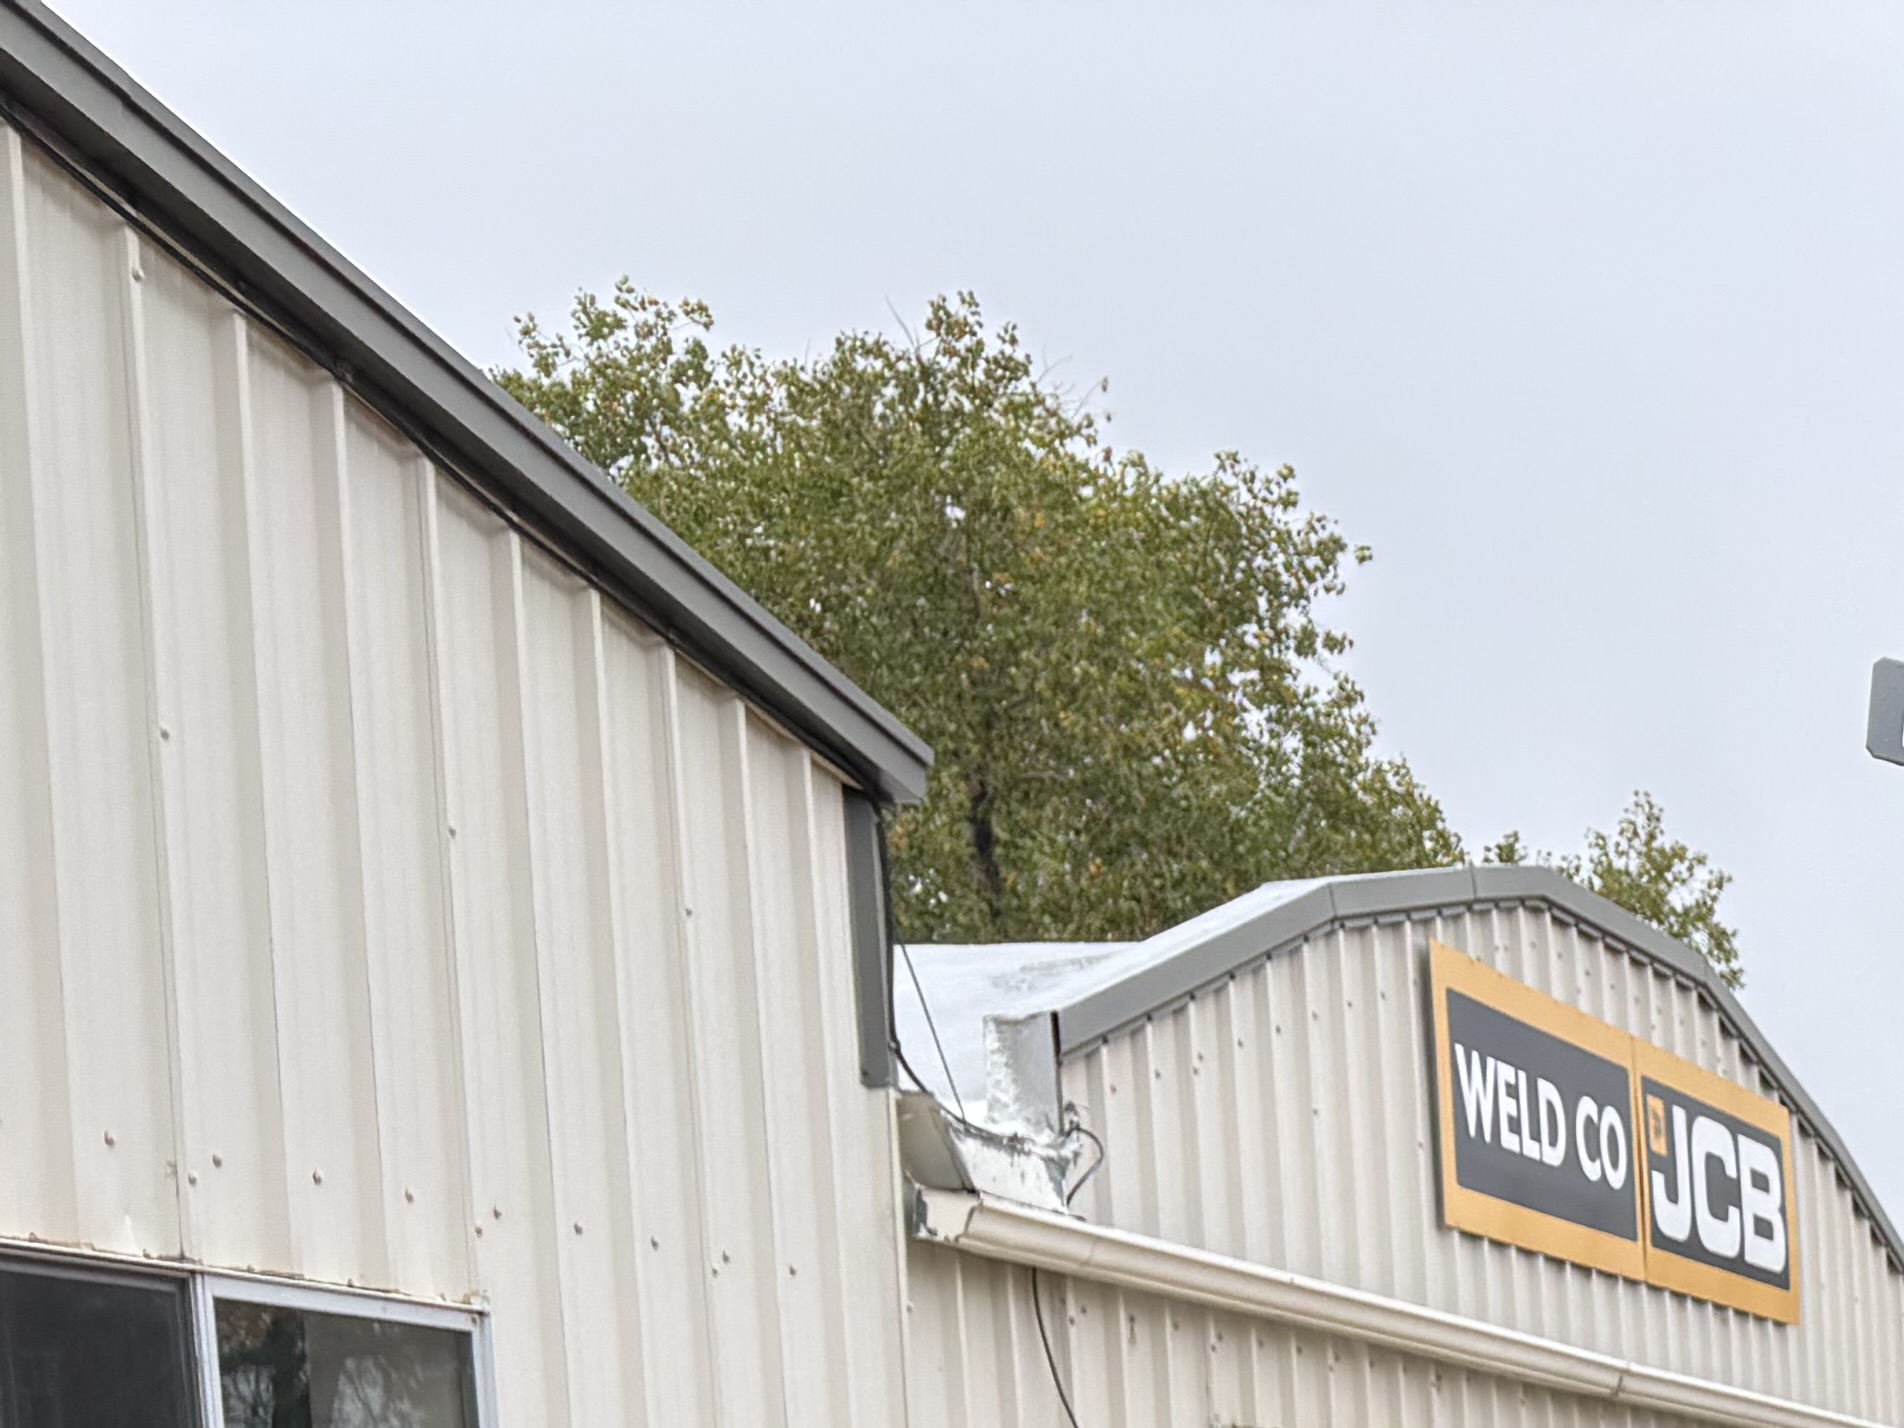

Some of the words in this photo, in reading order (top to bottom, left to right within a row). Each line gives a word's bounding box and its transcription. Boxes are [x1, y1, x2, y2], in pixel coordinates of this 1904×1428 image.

[1454, 1042, 1567, 1167] WELD
[1575, 1095, 1628, 1190] CO
[1649, 1101, 1787, 1275] JCB
